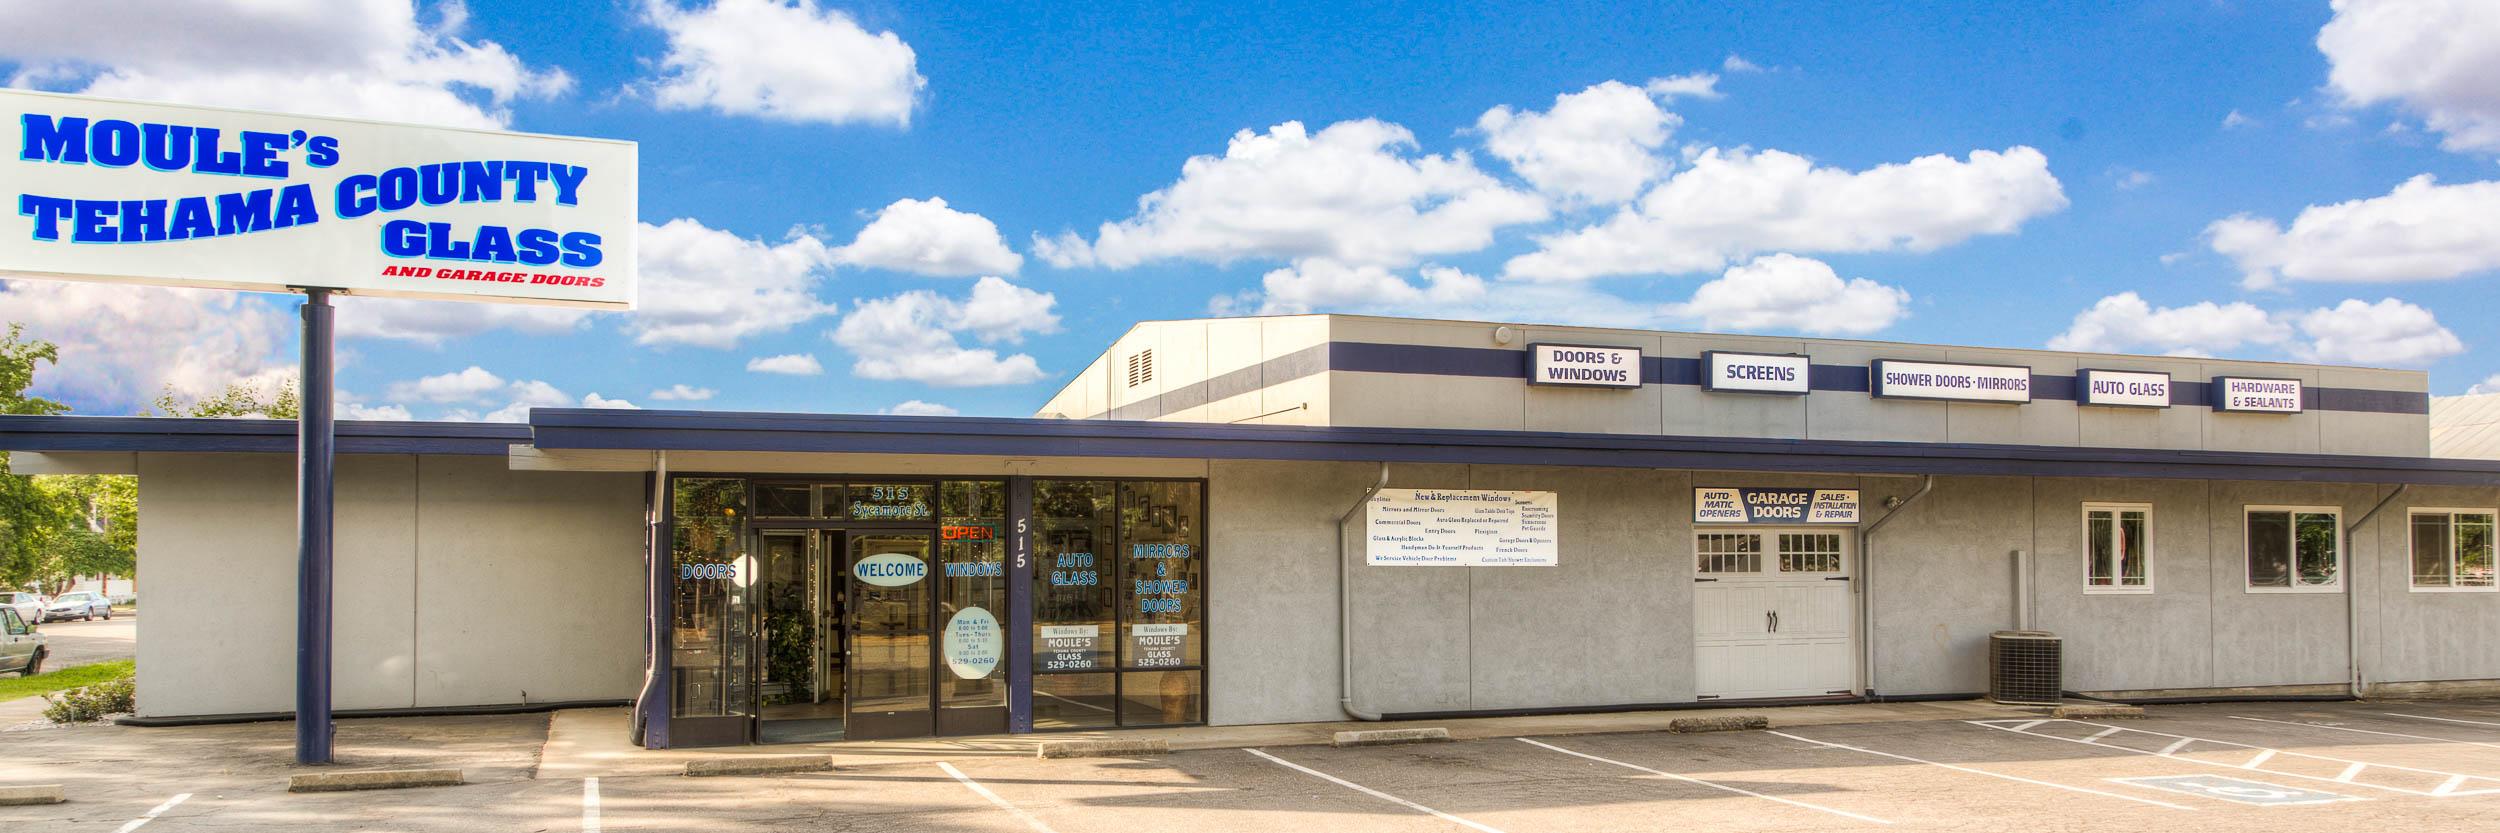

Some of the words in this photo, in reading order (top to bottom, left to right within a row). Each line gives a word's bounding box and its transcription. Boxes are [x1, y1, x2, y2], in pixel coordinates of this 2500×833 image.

[19, 183, 319, 244] TEHAMA
[334, 160, 588, 219] COUNTY
[380, 219, 603, 268] GLASS
[382, 266, 432, 278] AND
[436, 269, 527, 283] GARAGE
[530, 274, 605, 287] DOORS
[1553, 350, 1605, 364] DOORS
[1611, 353, 1623, 365] &
[1548, 367, 1627, 382] WINDOWS
[1726, 364, 1795, 382] SCREENS
[1886, 372, 1932, 387] SHOWER
[2093, 380, 2125, 395] AUTO
[2129, 382, 2165, 396] GLASS
[2231, 381, 2295, 395] HARDWARE
[2233, 396, 2241, 407] &
[2244, 396, 2294, 408] SEALANTS
[1415, 493, 1430, 501] New
[1430, 493, 1437, 501] &
[1437, 493, 1480, 502] Replacement
[1481, 494, 1511, 502] Windows
[1704, 500, 1734, 508] MATIC
[1747, 492, 1808, 504] GARAGE
[1813, 501, 1857, 509] INSTALLATION
[852, 501, 911, 518] Sycamore
[1699, 509, 1741, 518] OPENERS
[1753, 506, 1801, 518] DOORS
[1816, 510, 1822, 518] &
[1824, 510, 1853, 518] REPAIR
[943, 525, 993, 540] OPEN
[1133, 544, 1190, 559] MIRRORS
[1056, 552, 1094, 568] AUTO
[681, 563, 736, 580] DOORS
[857, 562, 924, 577] WELCOME
[945, 561, 1002, 577] WINDOWS
[1156, 562, 1167, 576] &
[1051, 570, 1098, 586] GLASS
[1135, 579, 1188, 595] SHOWER
[1141, 598, 1182, 613] DOORS
[1048, 638, 1091, 647] MOULE'S
[1139, 636, 1180, 645] MOULE'S
[1047, 660, 1091, 669] 529-0260
[1138, 658, 1181, 666] 529-0260
